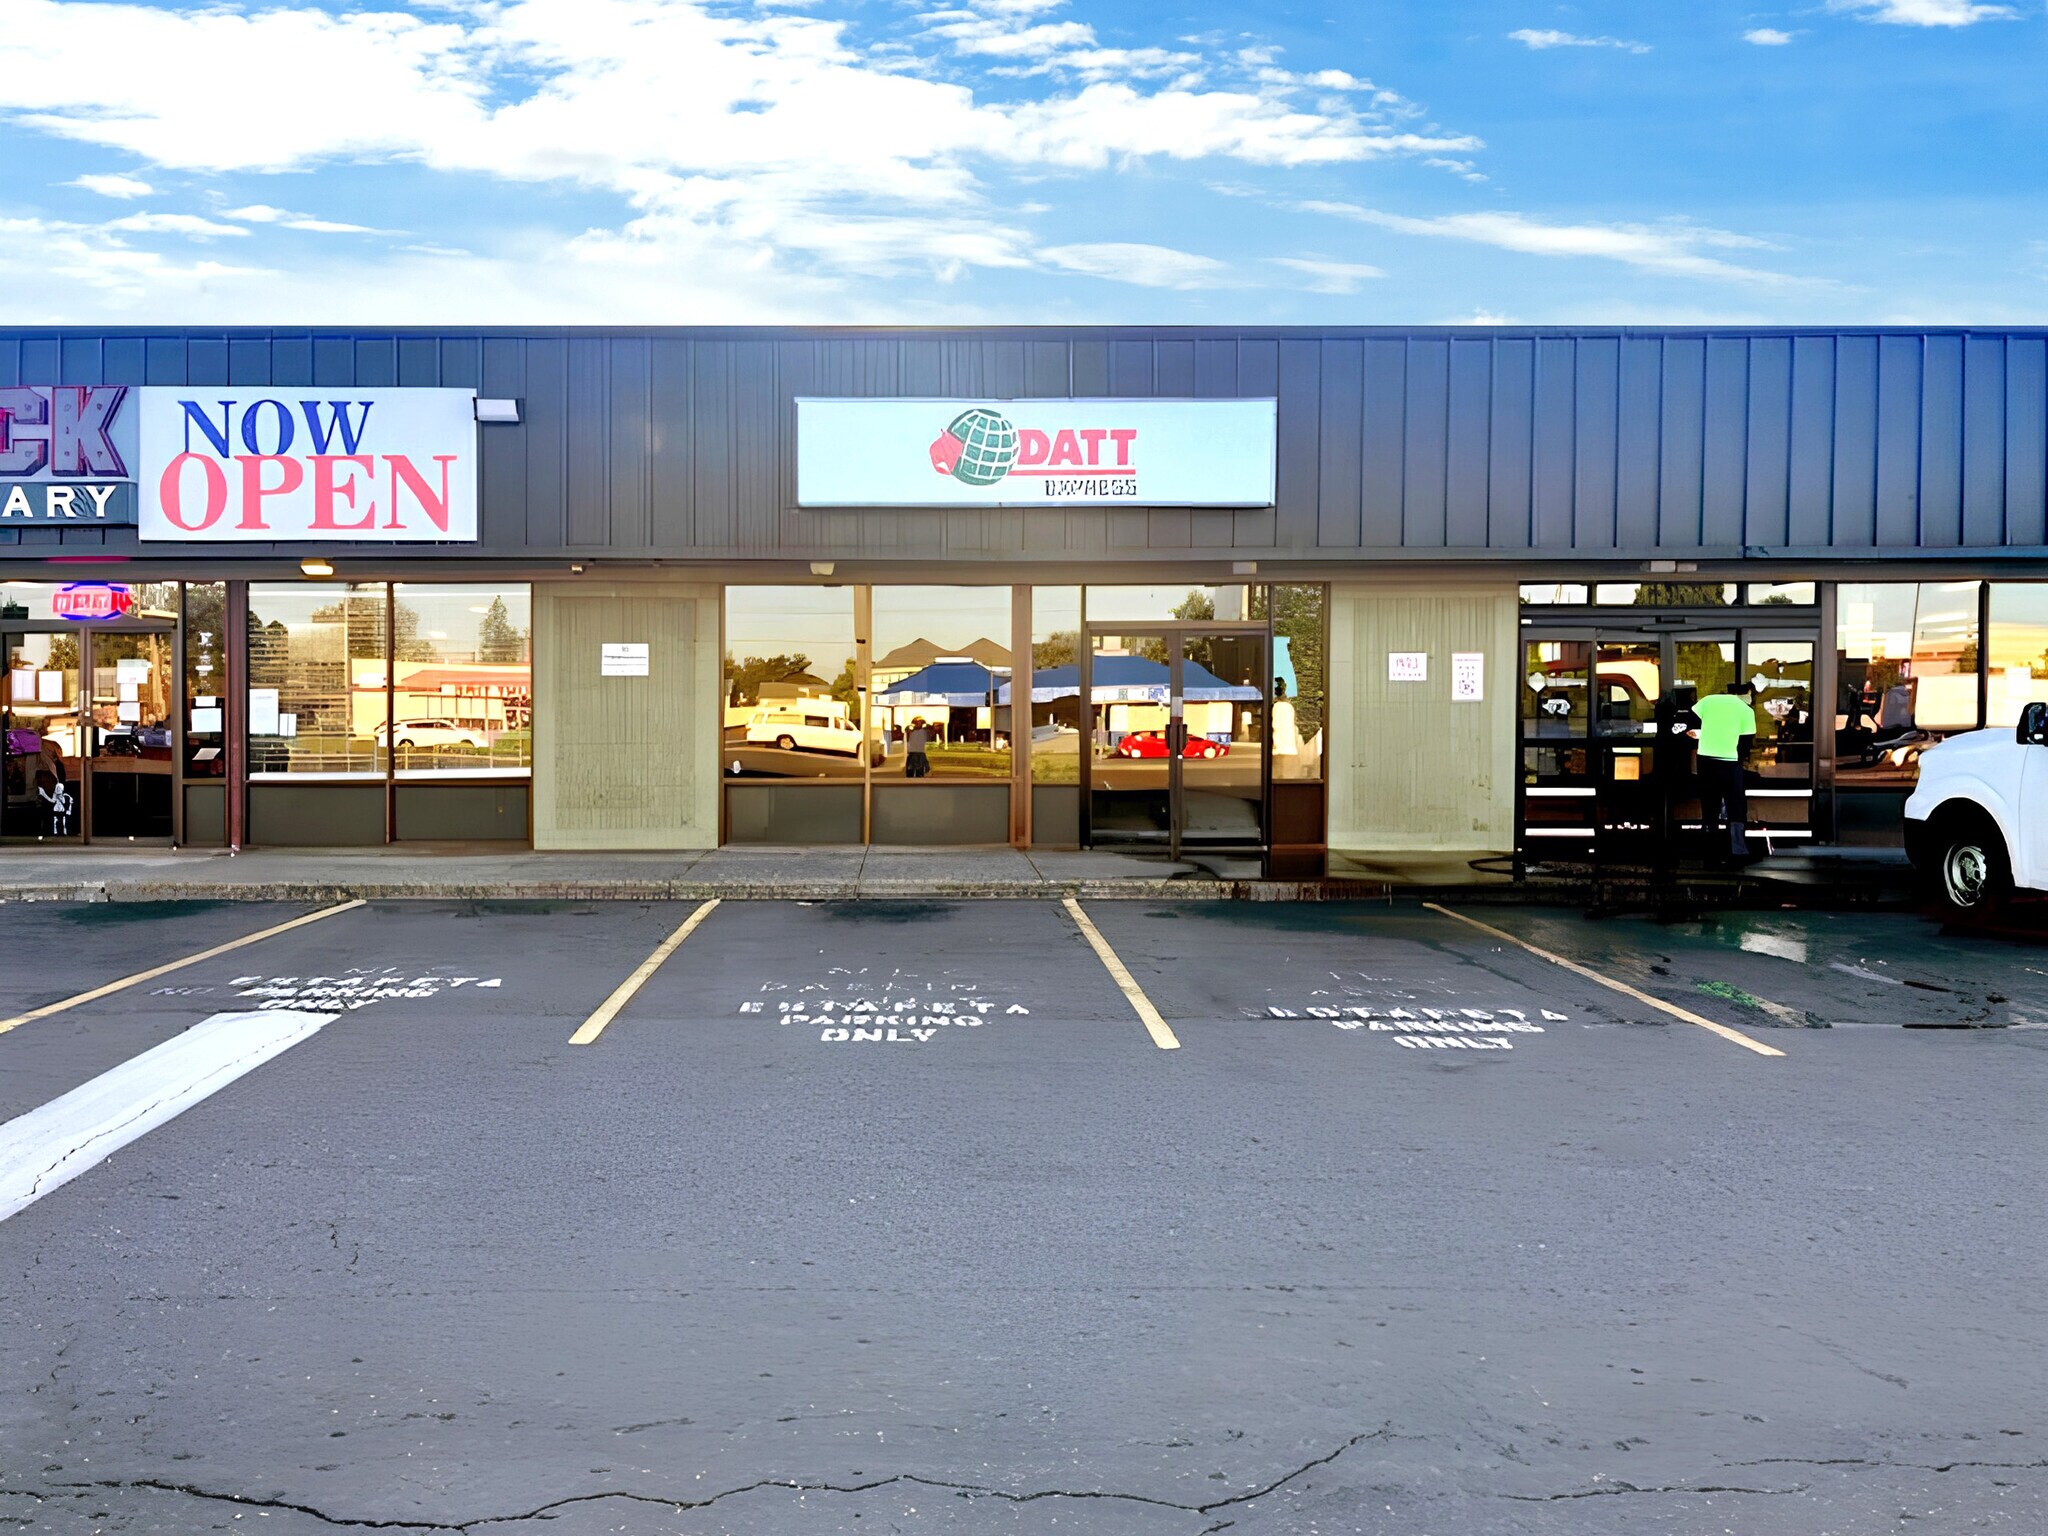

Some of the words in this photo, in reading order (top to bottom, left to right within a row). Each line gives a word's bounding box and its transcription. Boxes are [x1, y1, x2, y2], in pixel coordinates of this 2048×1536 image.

[178, 399, 375, 458] NOW
[1017, 429, 1137, 465] DATT
[2, 485, 116, 518] ARY
[159, 451, 458, 532] OPEN
[820, 1028, 937, 1042] ONLY
